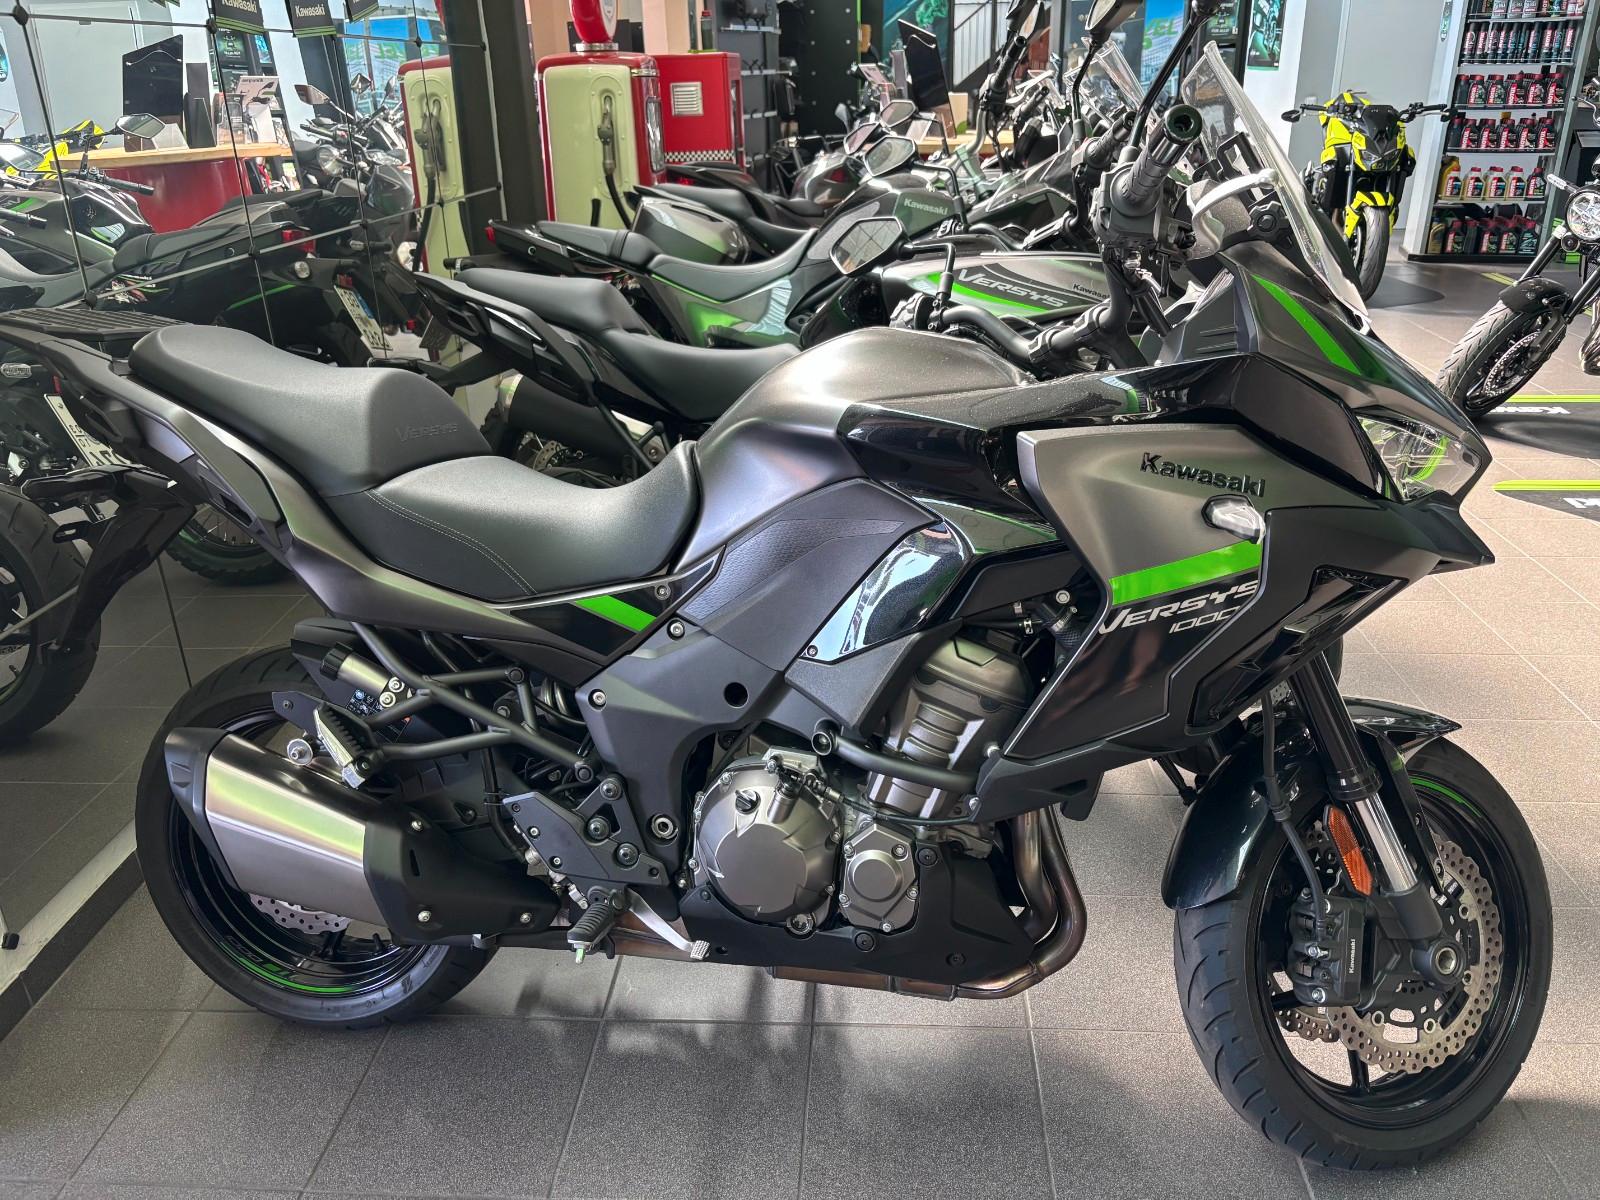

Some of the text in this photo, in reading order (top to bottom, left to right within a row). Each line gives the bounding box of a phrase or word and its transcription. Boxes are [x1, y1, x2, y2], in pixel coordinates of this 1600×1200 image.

[222, 0, 258, 13] Kawasaki
[295, 4, 325, 17] Kawasaki
[903, 198, 949, 216] Kawasaki
[1073, 283, 1110, 299] Kawasa
[1139, 452, 1266, 498] Kawasaki
[1348, 938, 1357, 974] Kawasaki
